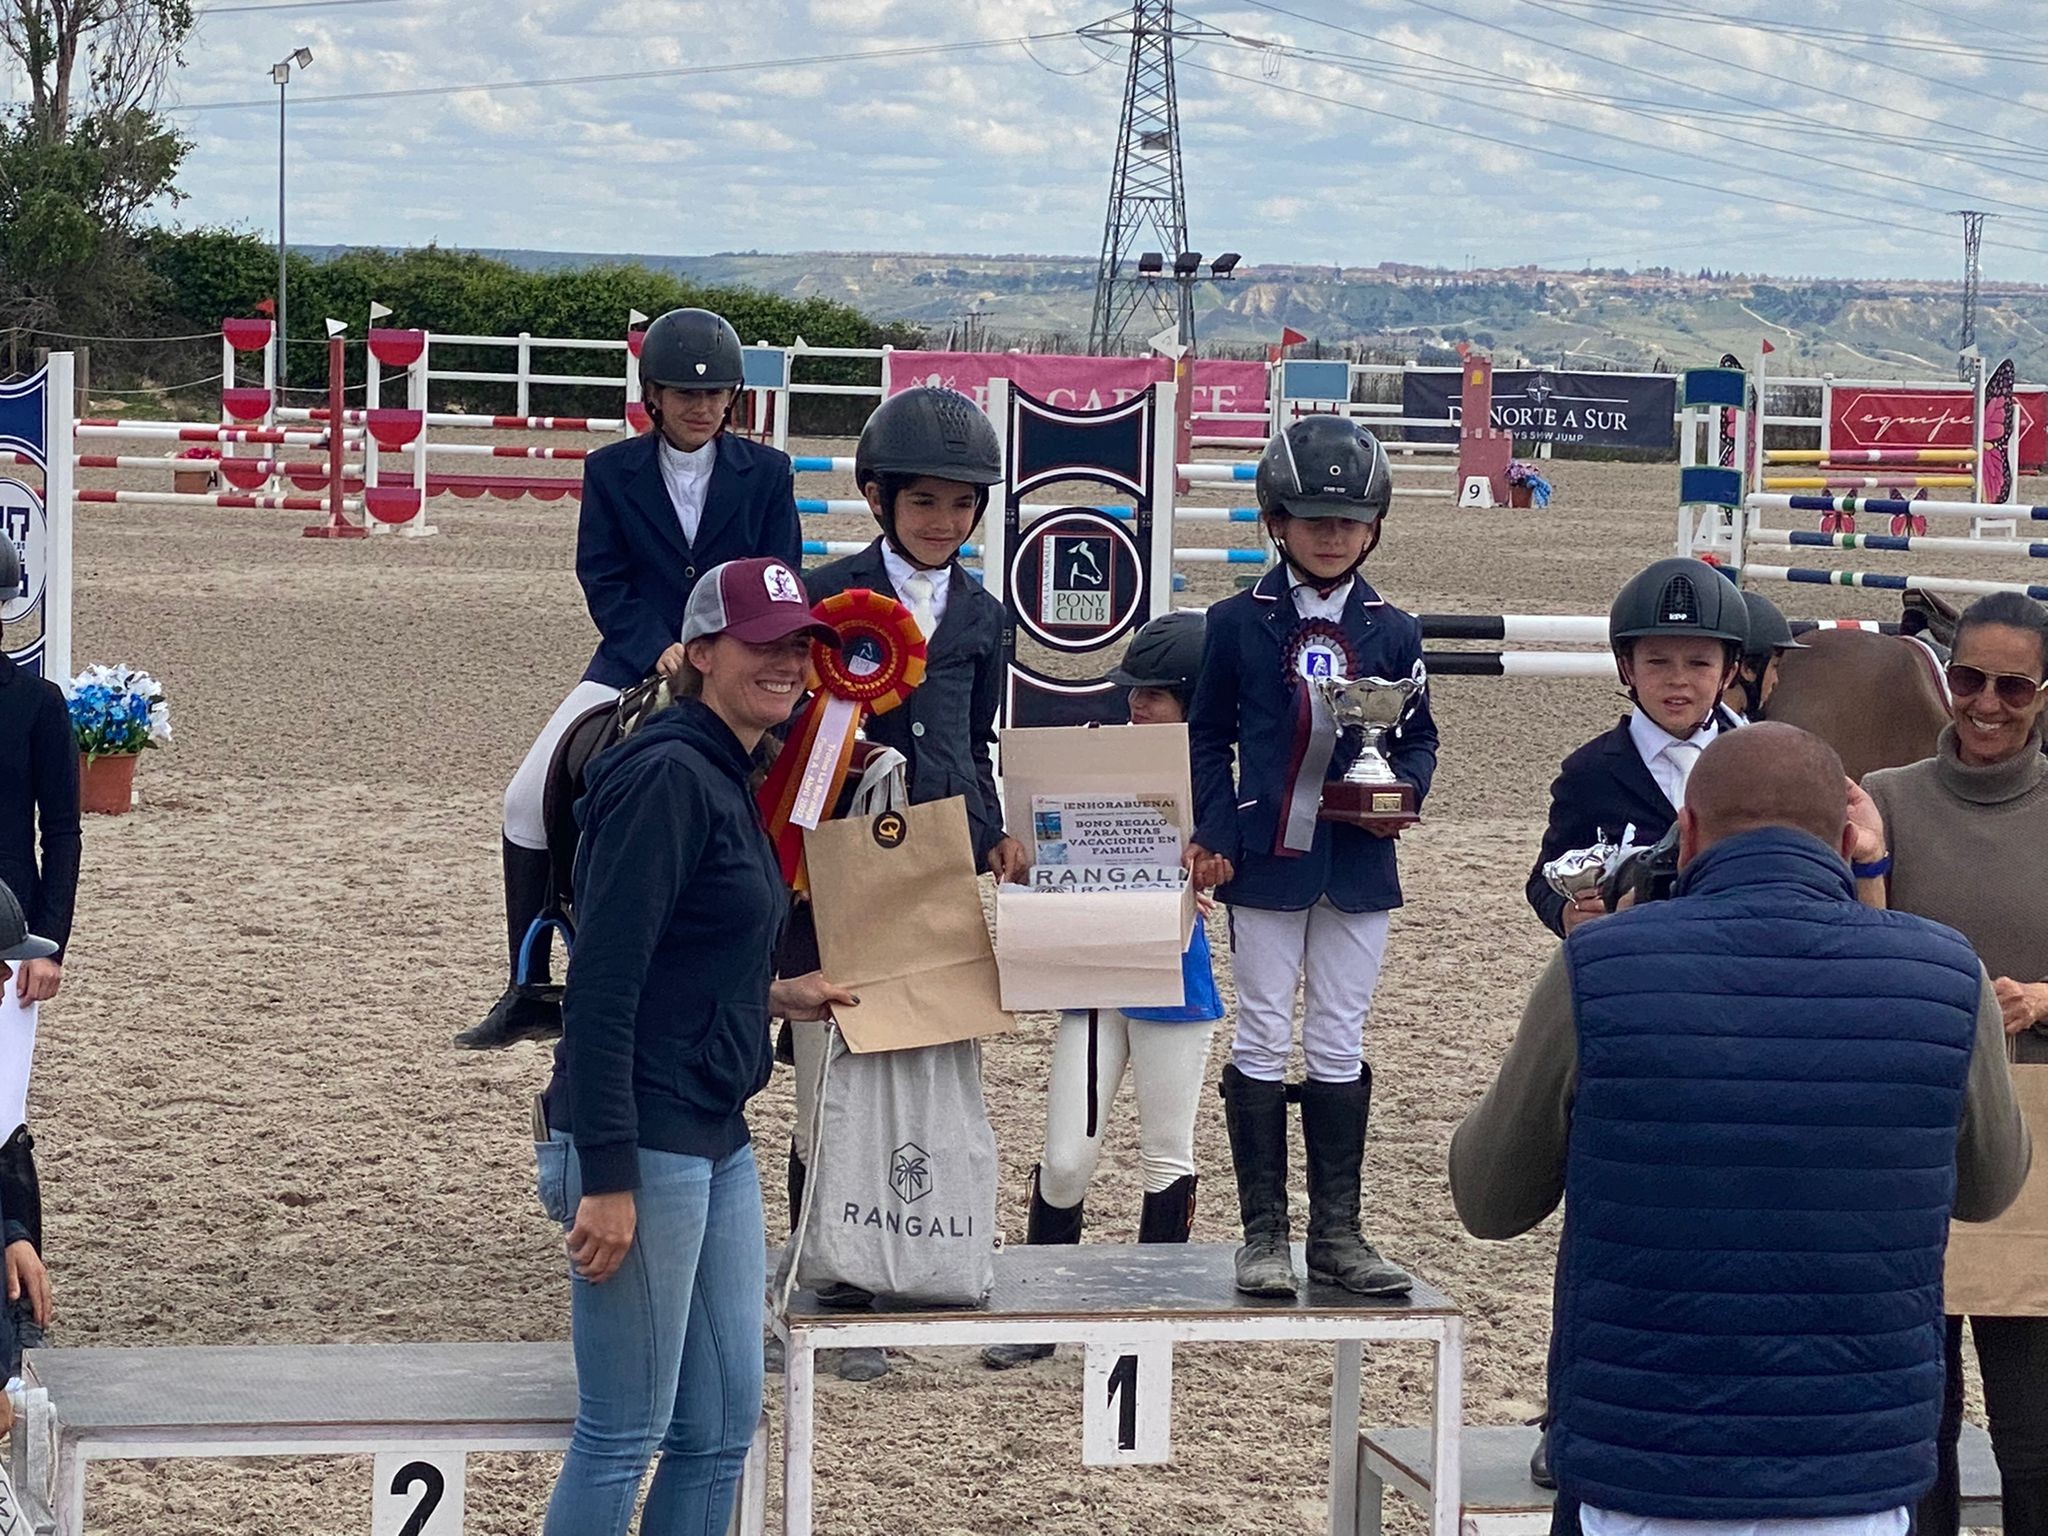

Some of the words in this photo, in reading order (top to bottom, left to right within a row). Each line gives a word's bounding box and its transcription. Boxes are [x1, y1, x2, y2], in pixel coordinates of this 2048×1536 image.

[1490, 406, 1556, 426] NORTE
[1562, 410, 1578, 427] A
[1584, 408, 1628, 430] SUR
[1860, 407, 1974, 442] equipe
[1555, 433, 1584, 441] JUMP
[1469, 484, 1480, 499] 9
[1057, 592, 1106, 607] PONY
[1056, 606, 1105, 621] CLUB
[1075, 820, 1112, 828] BONO
[1115, 819, 1168, 827] REGALO
[1084, 829, 1120, 837] PARA
[1123, 828, 1160, 836] UNAS
[1068, 837, 1154, 846] VACACIONES
[1158, 836, 1176, 844] EN
[843, 1202, 972, 1238] RANGALI
[1106, 1355, 1138, 1450] 1
[390, 1461, 444, 1536] 2
